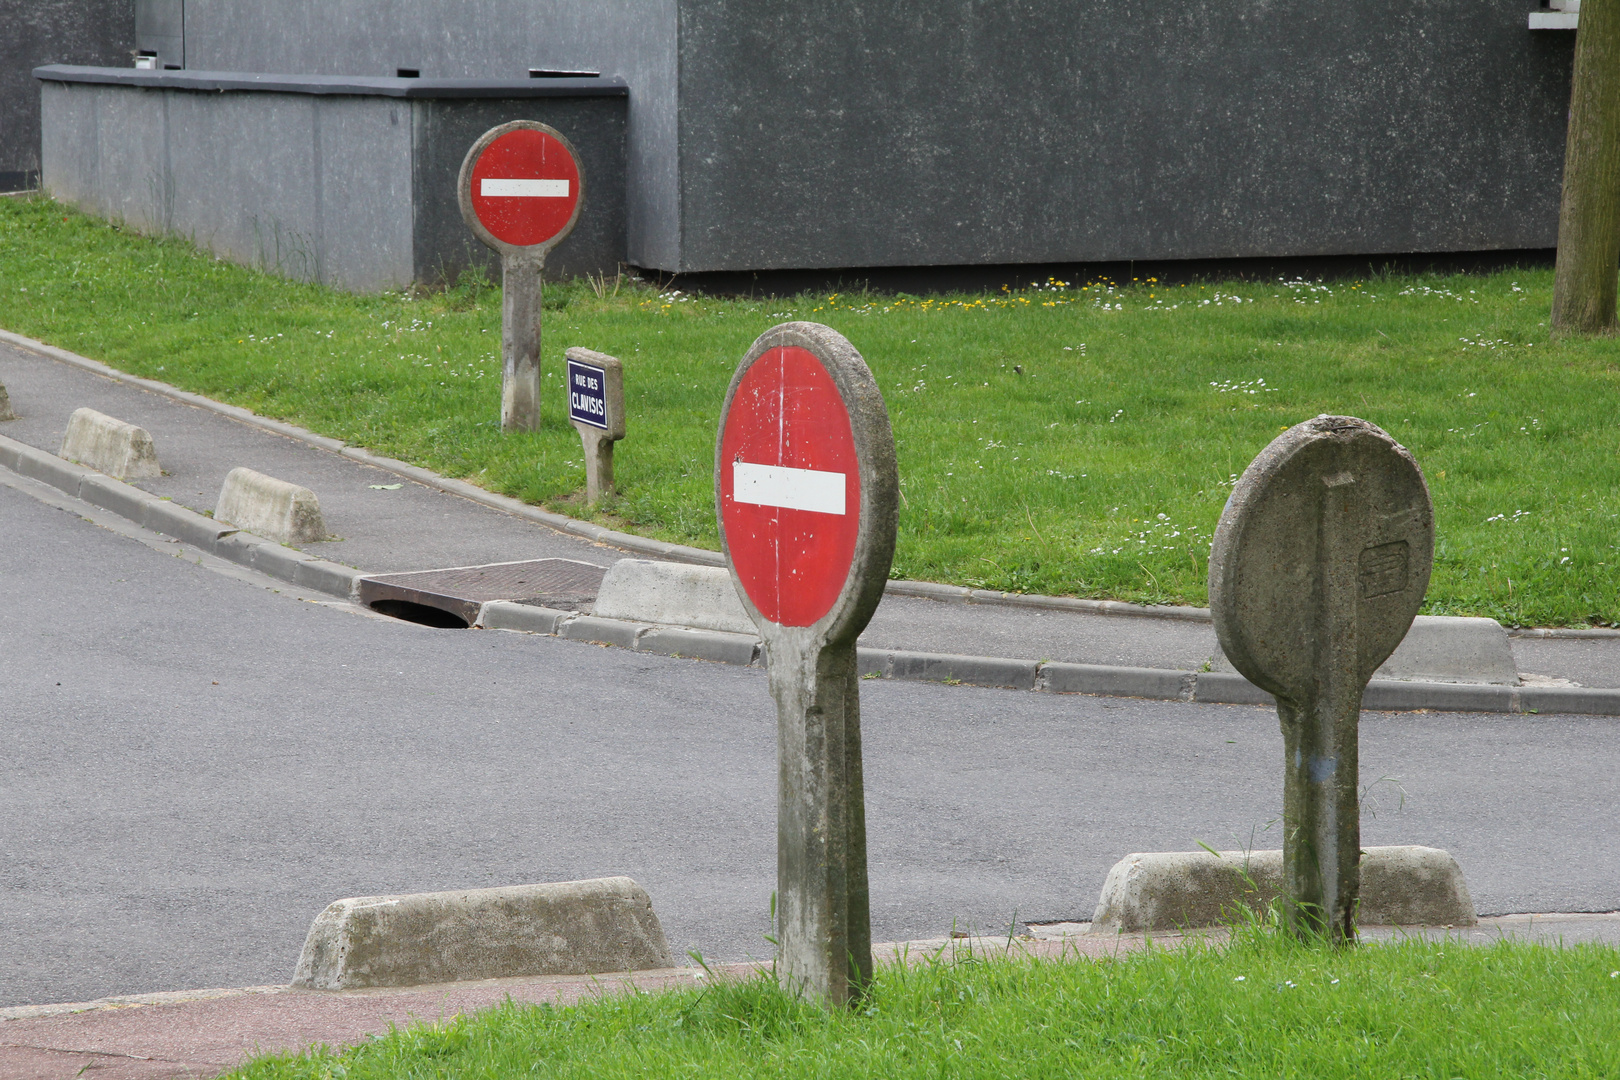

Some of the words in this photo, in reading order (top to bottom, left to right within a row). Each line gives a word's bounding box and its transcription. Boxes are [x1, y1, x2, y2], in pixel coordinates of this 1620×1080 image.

[575, 374, 586, 387] RUE
[587, 377, 598, 390] DES
[572, 392, 604, 416] CLAVISIS
